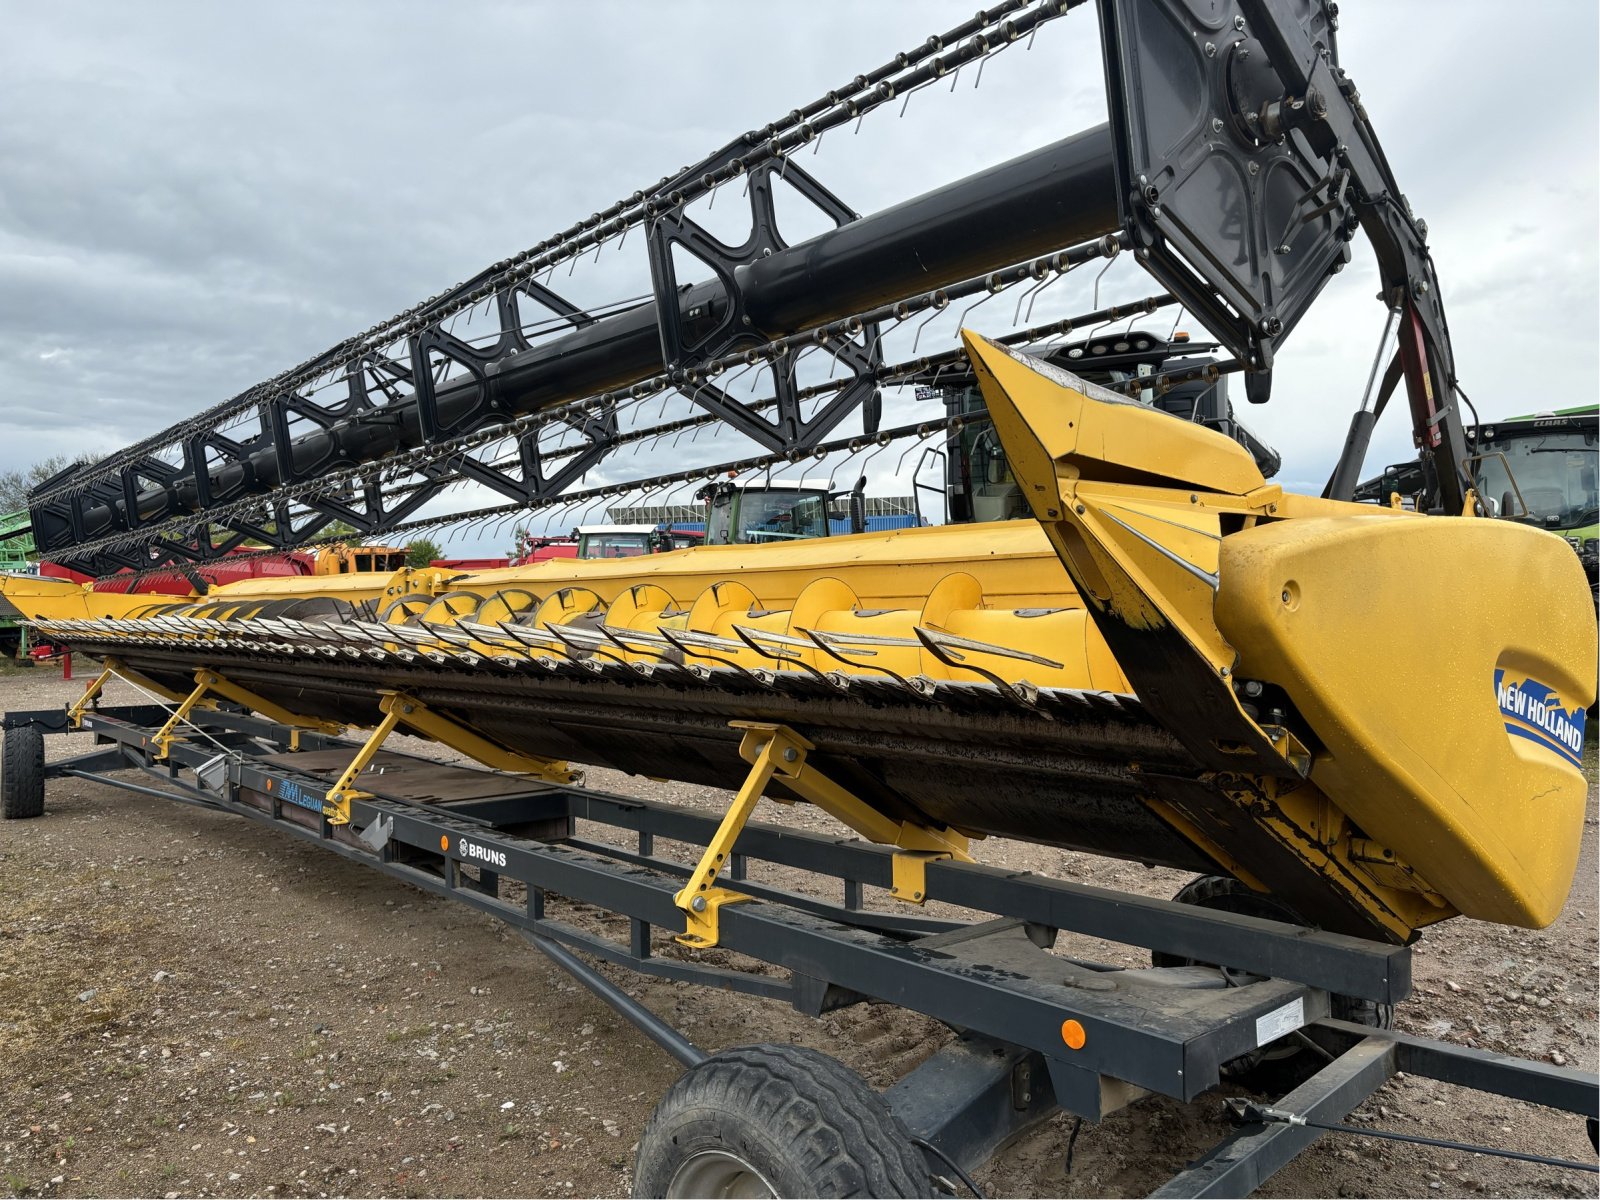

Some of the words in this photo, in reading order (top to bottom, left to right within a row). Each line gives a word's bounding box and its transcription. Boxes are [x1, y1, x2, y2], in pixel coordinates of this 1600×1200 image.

[1533, 419, 1568, 427] CLAAS
[1497, 682, 1527, 716] NEW
[1527, 696, 1582, 753] HOLLAND
[468, 843, 507, 867] BRUNS
